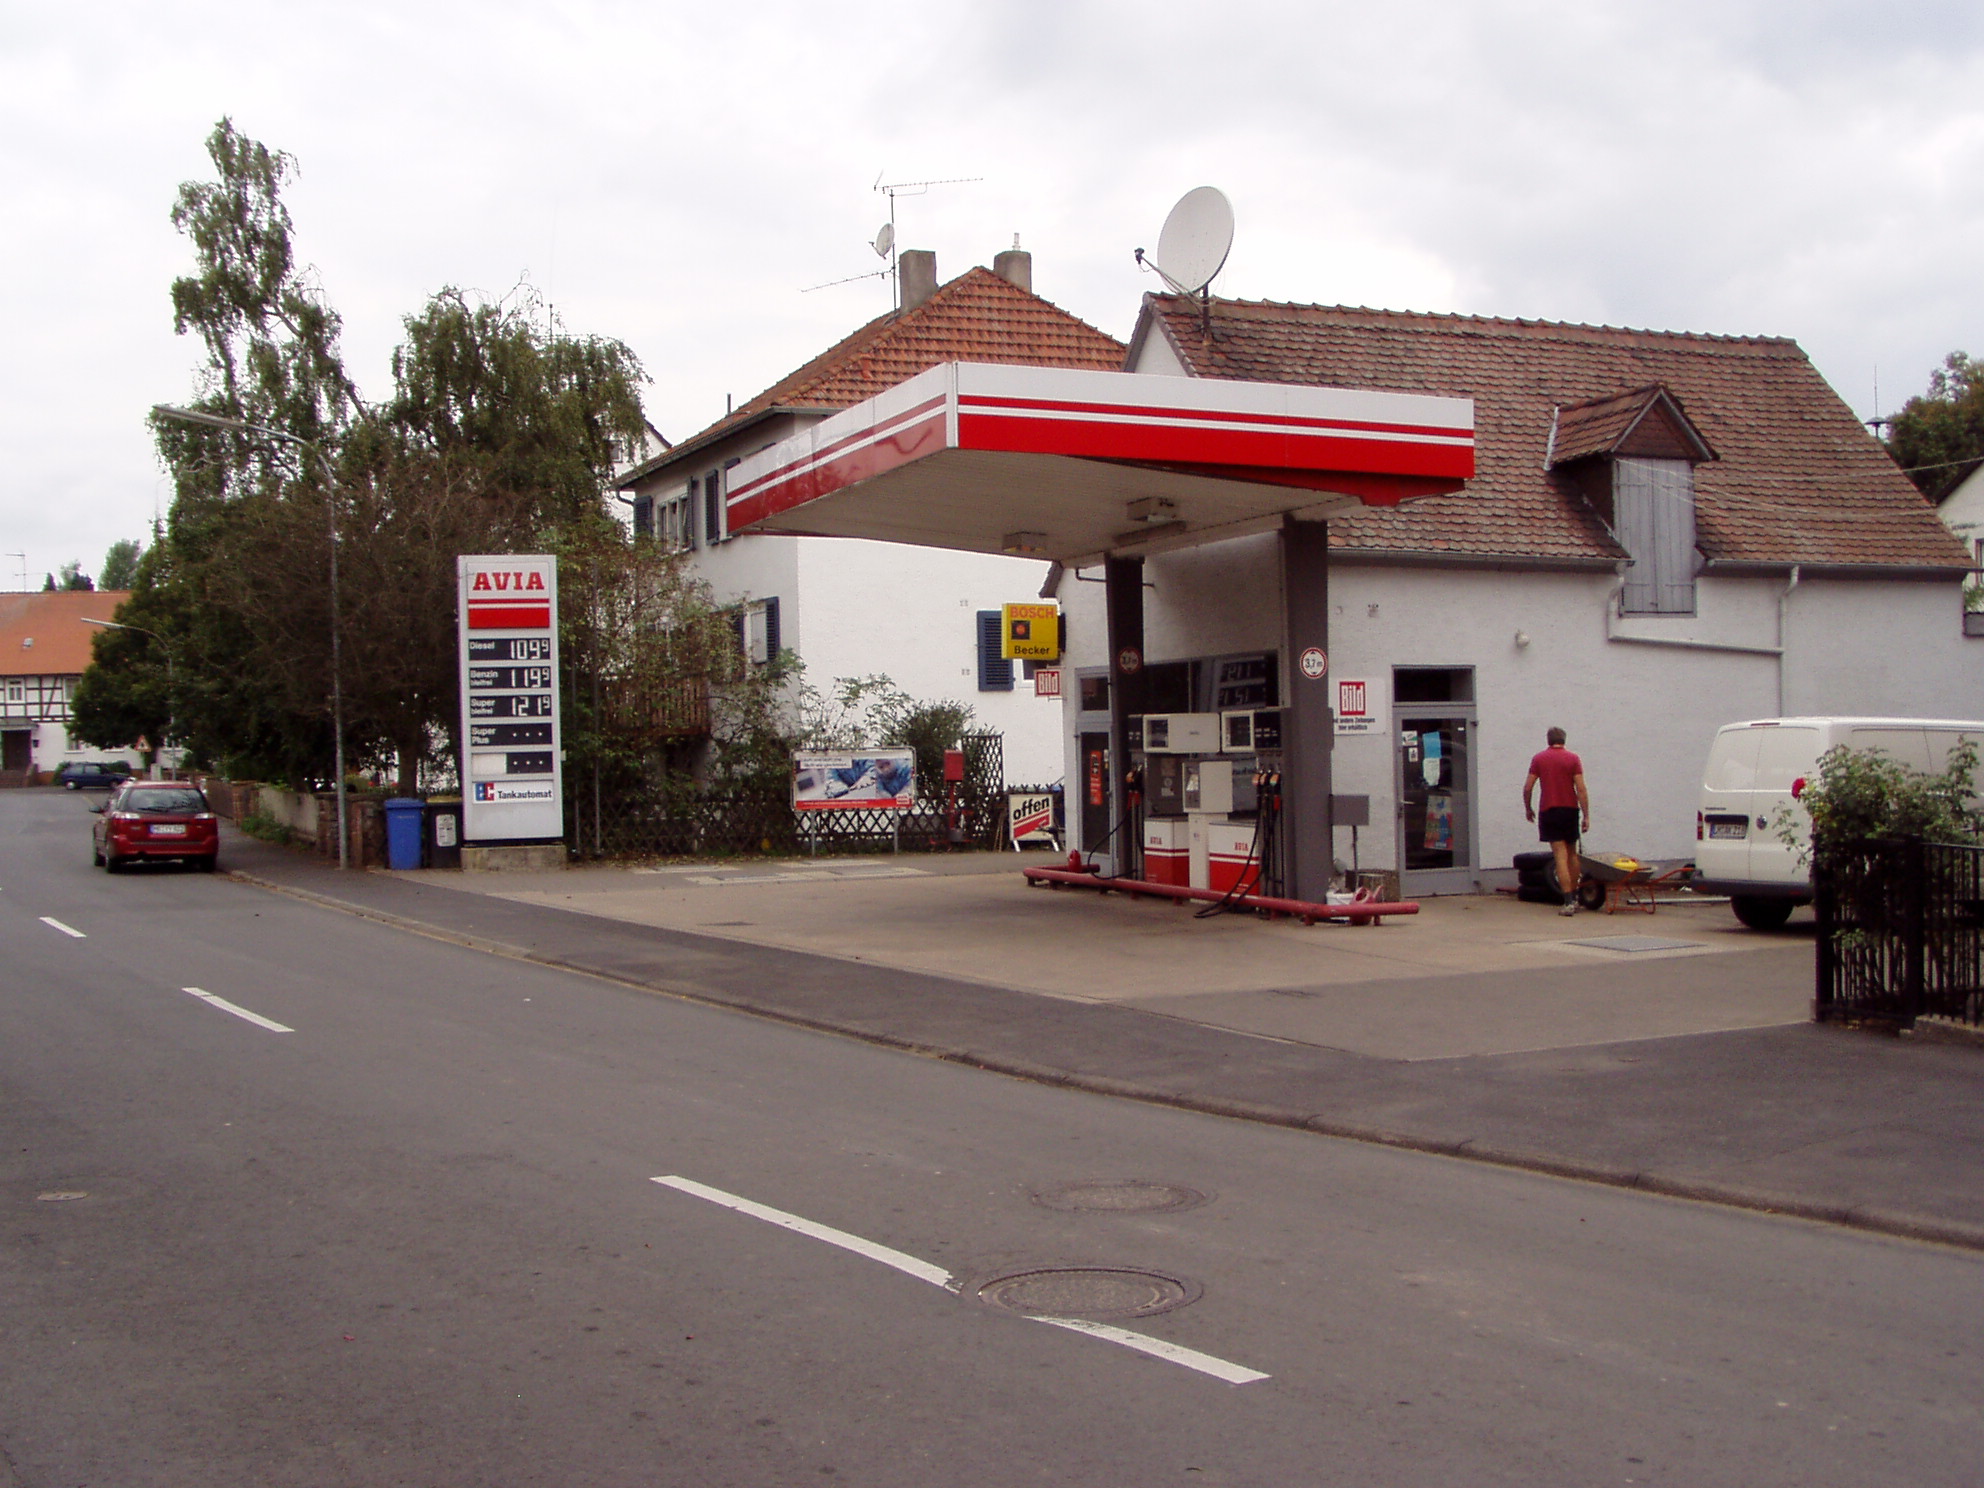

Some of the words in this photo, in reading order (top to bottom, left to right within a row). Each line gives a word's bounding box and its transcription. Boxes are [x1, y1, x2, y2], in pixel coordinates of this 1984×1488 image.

[472, 572, 545, 591] AVIA
[1010, 606, 1055, 619] BOSCH
[469, 641, 495, 650] Diesel
[1014, 645, 1050, 655] Becker
[470, 669, 499, 679] Benzin
[1038, 672, 1058, 693] Bild
[471, 698, 495, 707] Super
[1341, 685, 1364, 712] Bild
[471, 727, 496, 736] Super
[472, 736, 489, 744] Plus
[498, 790, 552, 799] Tankautomat
[1013, 797, 1050, 820] offen
